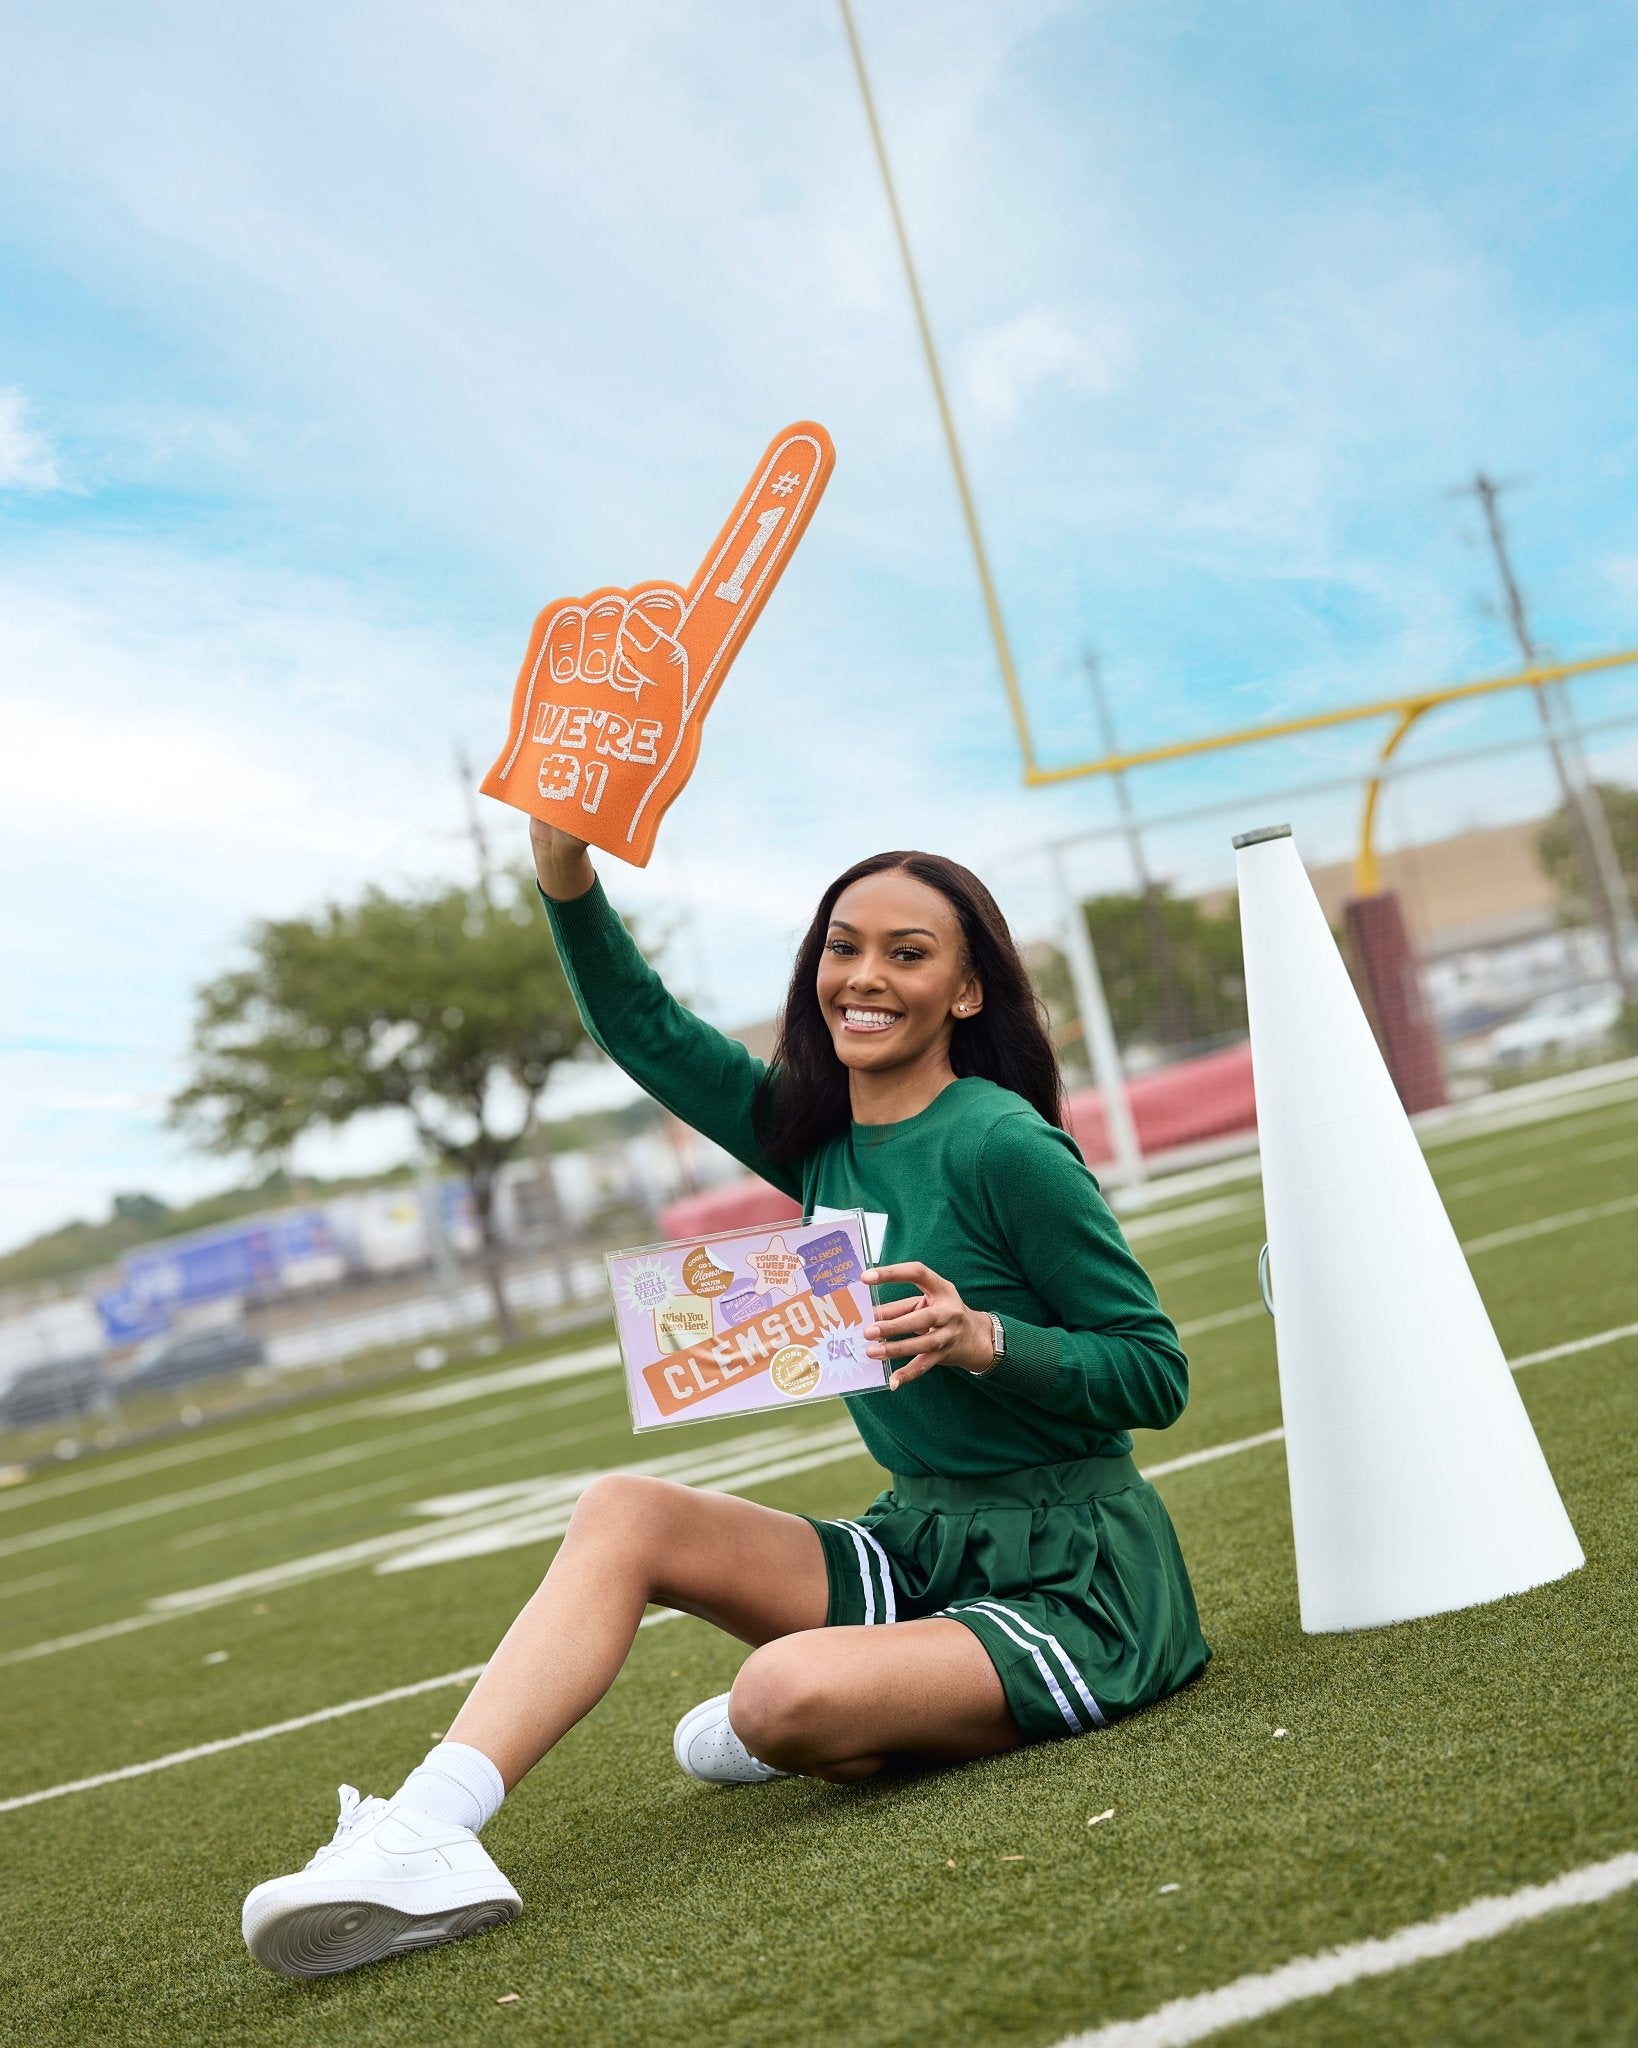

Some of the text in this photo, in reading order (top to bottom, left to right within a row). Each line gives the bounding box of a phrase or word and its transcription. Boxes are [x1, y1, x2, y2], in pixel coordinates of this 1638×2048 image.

[532, 701, 664, 766] WE'RE
[536, 753, 610, 815] #1
[687, 1253, 704, 1267] GOOD
[755, 1253, 779, 1262] YOUR
[810, 1245, 843, 1264] CLEMSON
[756, 1261, 785, 1270] LIVES
[834, 1260, 854, 1274] GOOD
[762, 1269, 791, 1277] TIGER
[633, 1276, 665, 1293] HELL
[700, 1279, 721, 1288] SOUTH
[764, 1276, 789, 1285] TOWN
[634, 1283, 668, 1301] YEAH
[696, 1284, 727, 1294] CAROLINA
[661, 1312, 705, 1323] Wish You
[659, 1320, 709, 1333] Were Here!
[662, 1294, 844, 1400] CLEMSON
[779, 1351, 803, 1363] WORK
